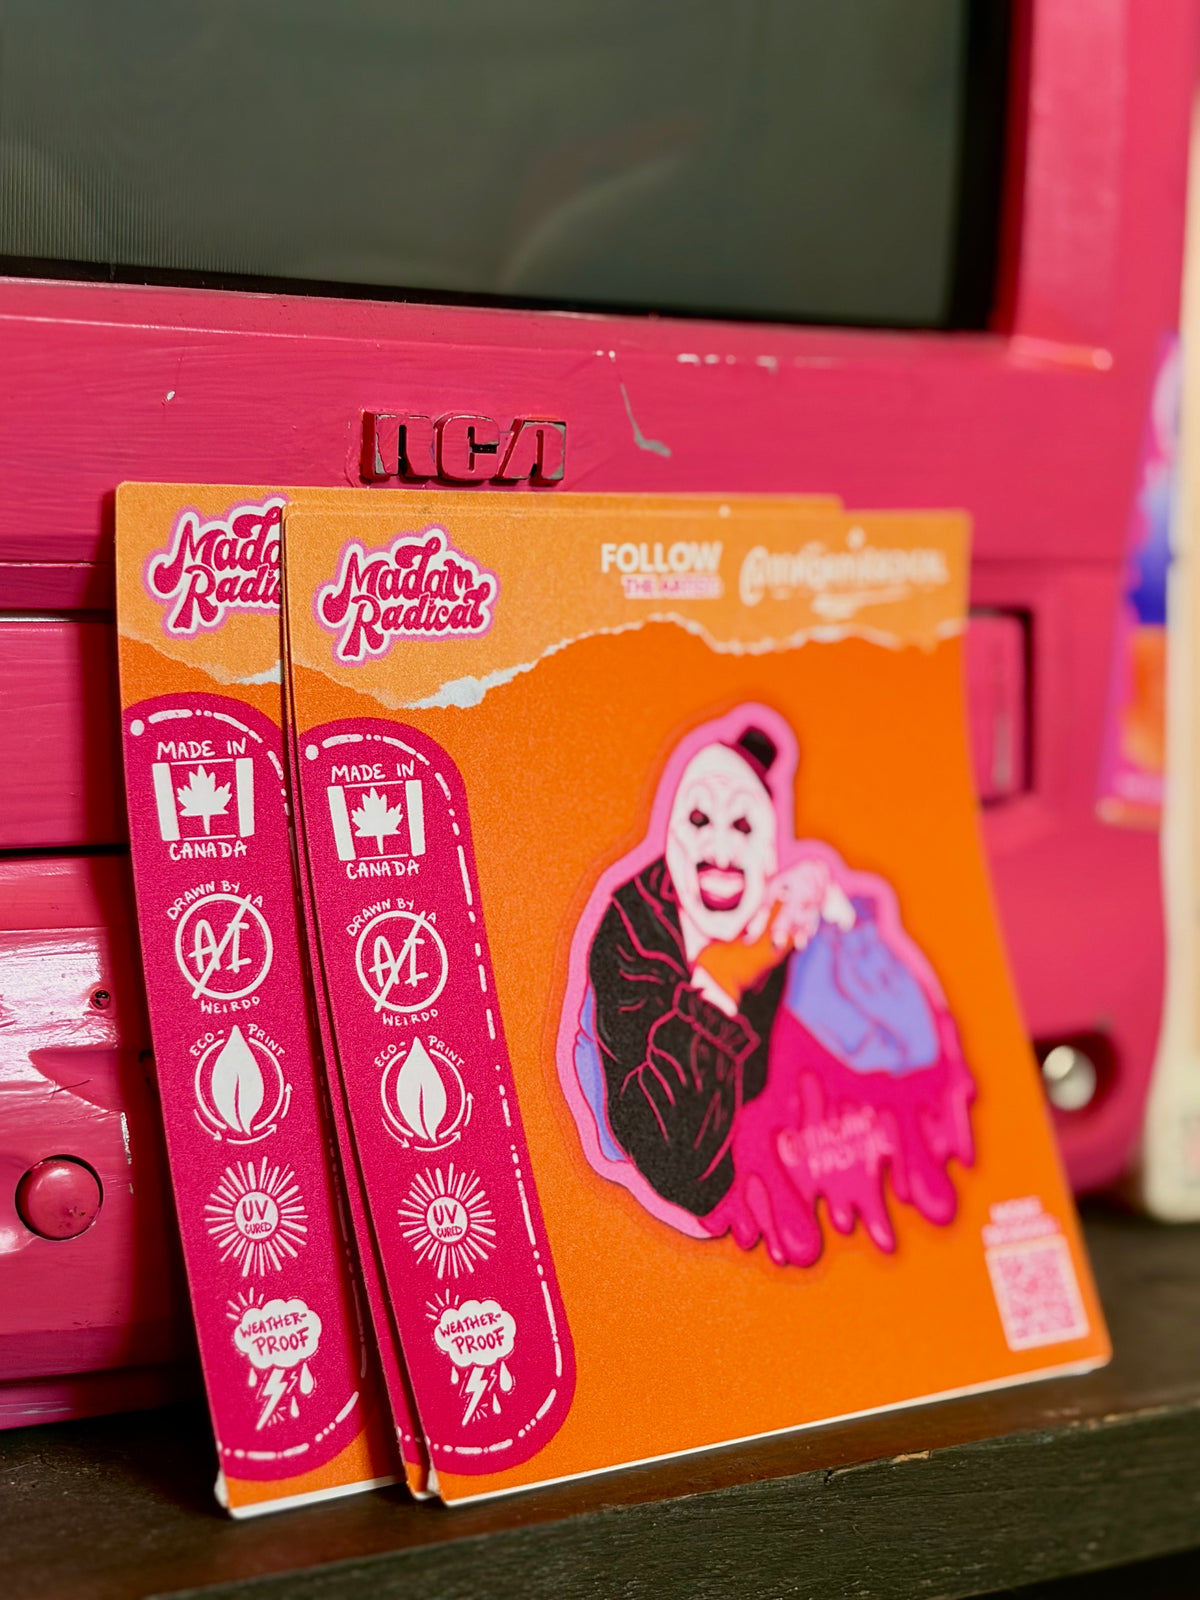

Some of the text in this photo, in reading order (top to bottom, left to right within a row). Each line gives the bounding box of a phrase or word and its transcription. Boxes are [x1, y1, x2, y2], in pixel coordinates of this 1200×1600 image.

[360, 410, 566, 482] RCA
[600, 540, 723, 574] FOLLOW
[322, 537, 474, 623] Madam
[342, 581, 490, 657] Radical
[156, 737, 247, 760] MADE IN
[331, 759, 415, 784] MADE IN
[169, 840, 248, 861] CANADA
[346, 859, 420, 880] CANADA
[166, 880, 264, 921] DRAWN BY A
[345, 897, 437, 937] DRAWN BY A
[200, 996, 261, 1015] WEIRDO
[382, 1008, 439, 1027] WEIRDO
[247, 1023, 286, 1058] PRINT
[427, 1035, 465, 1068] PRINT
[242, 1200, 269, 1222] UV
[433, 1204, 458, 1226] UV
[244, 1222, 273, 1235] CURED
[436, 1225, 463, 1238] CURED
[239, 1312, 307, 1339] WEATHER-
[438, 1312, 502, 1338] WEATHER-
[252, 1326, 309, 1356] PROOF
[450, 1326, 504, 1355] PROOF
